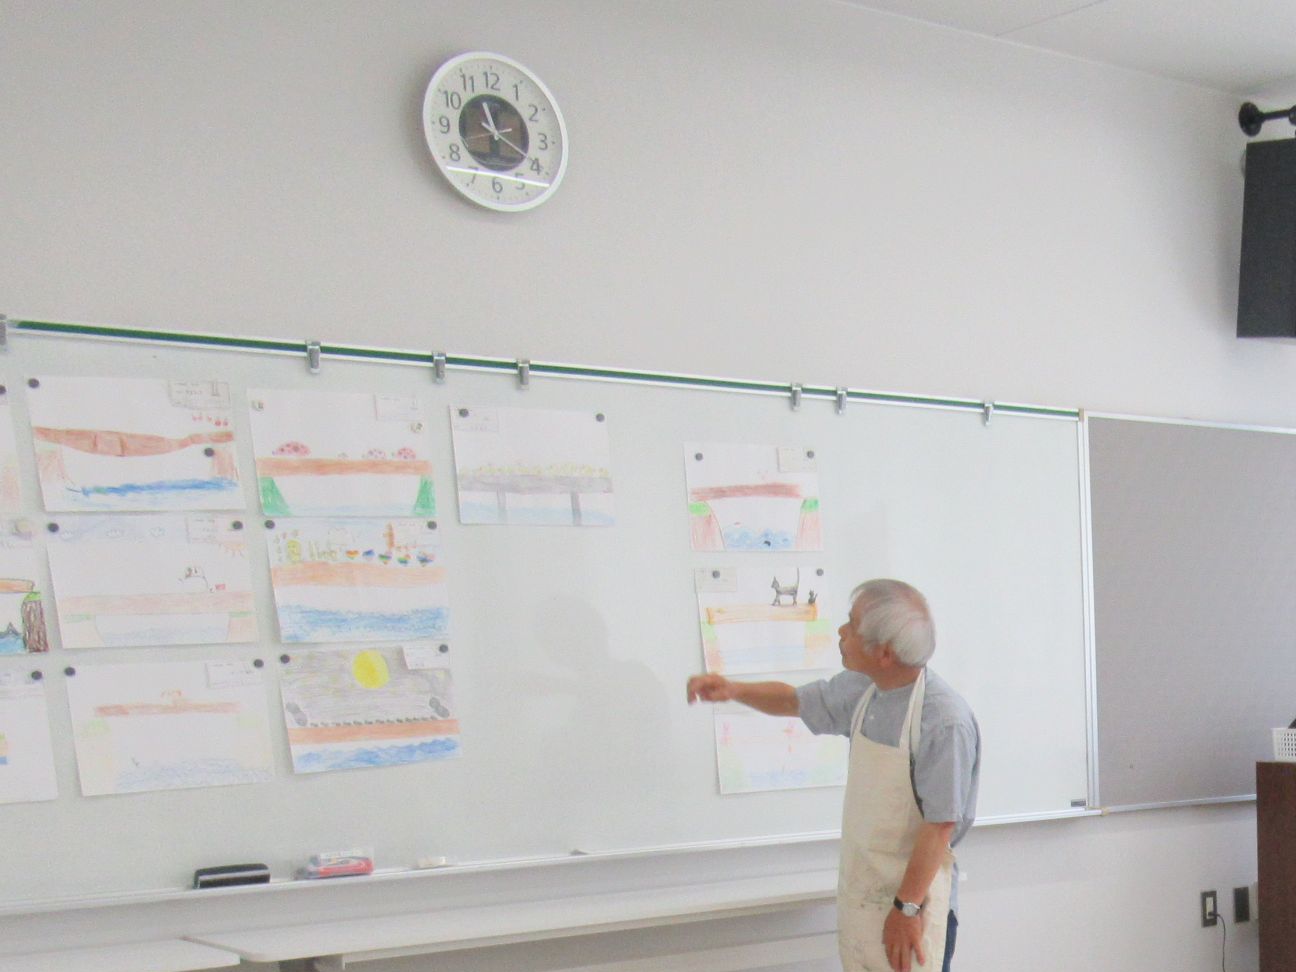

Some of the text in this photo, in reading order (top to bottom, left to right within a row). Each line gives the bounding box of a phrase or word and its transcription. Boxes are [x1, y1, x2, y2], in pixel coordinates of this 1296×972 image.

[460, 73, 475, 93] 11
[482, 71, 501, 92] 12
[443, 90, 462, 110] 10
[512, 83, 519, 101] 1
[528, 104, 539, 123] 2
[438, 116, 450, 134] 9
[538, 133, 548, 151] 3
[449, 144, 461, 162] 8
[468, 166, 479, 184] 7
[530, 157, 542, 176] 4
[491, 176, 503, 194] 6
[514, 172, 525, 190] 5
